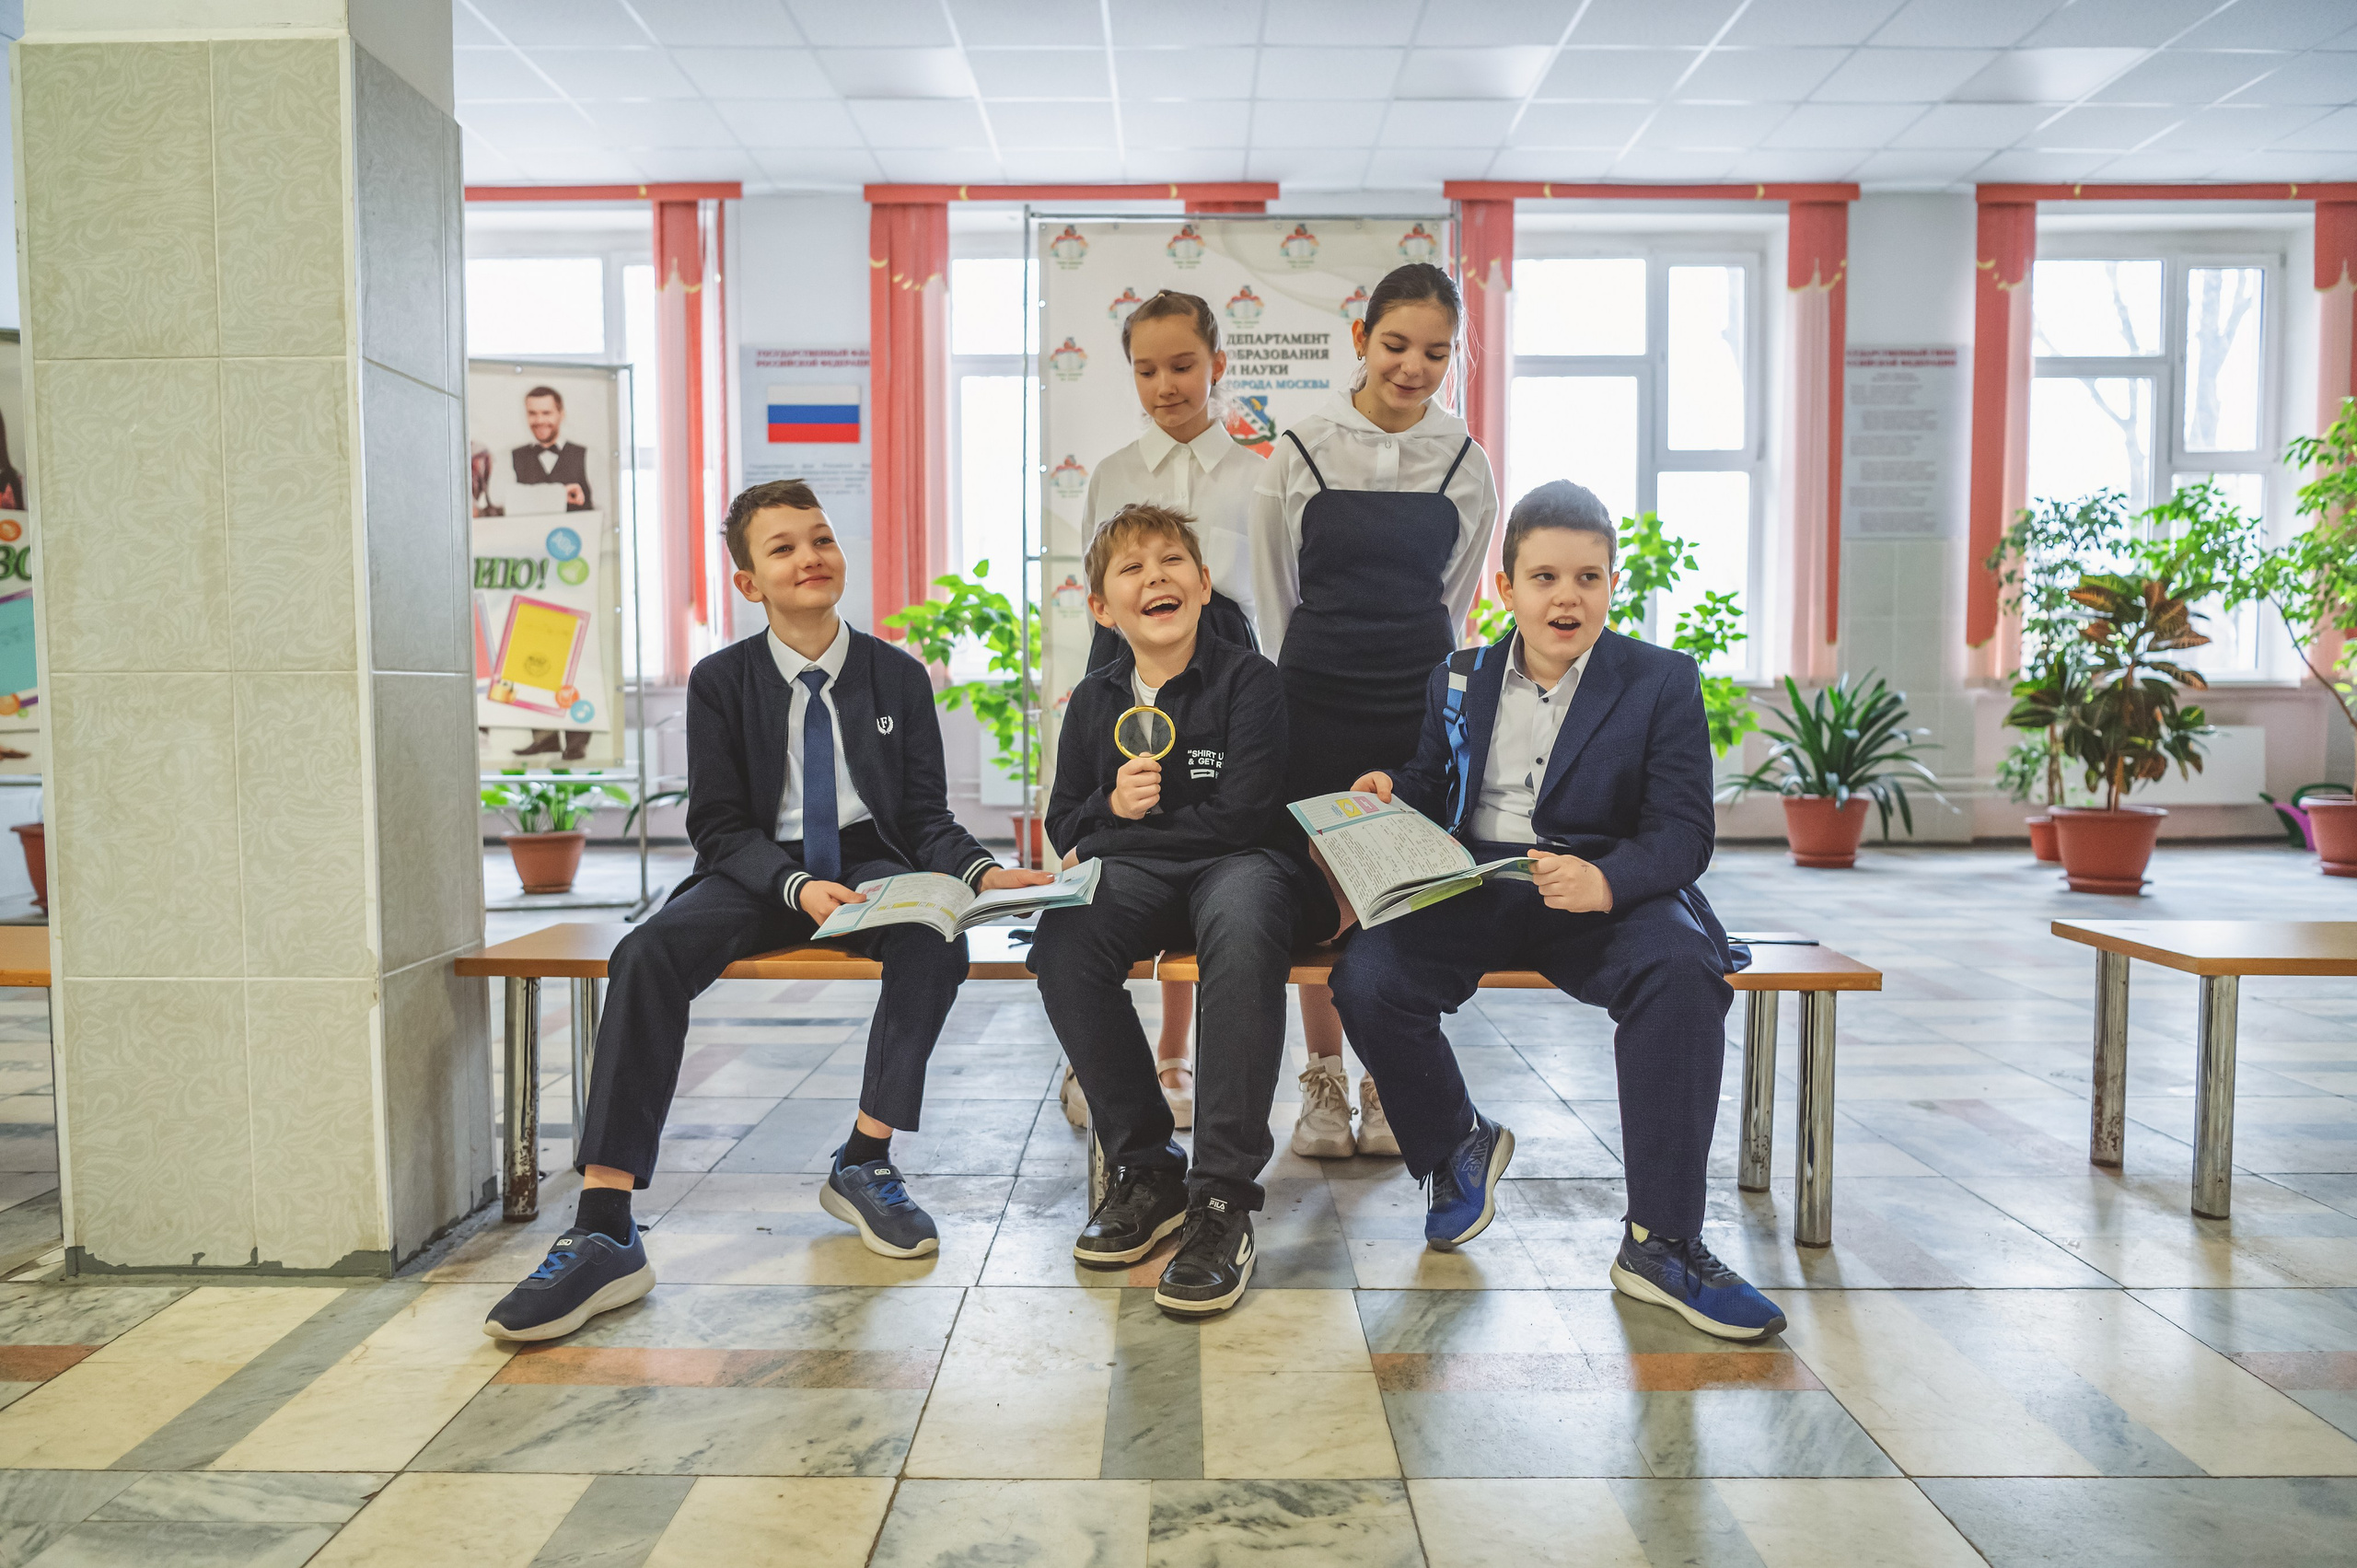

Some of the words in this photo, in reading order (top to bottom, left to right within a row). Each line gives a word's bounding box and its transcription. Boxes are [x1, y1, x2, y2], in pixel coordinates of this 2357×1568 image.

[1226, 333, 1330, 345] ДЕПАРТАМЕНТ
[1227, 349, 1329, 360] ОБРАЗОВАНИЯ
[1226, 365, 1237, 375] И
[1240, 364, 1289, 376] НАУКИ
[1276, 378, 1330, 389] МОСКВЫ
[1198, 757, 1215, 766] GET
[1209, 1200, 1225, 1211] FILA
